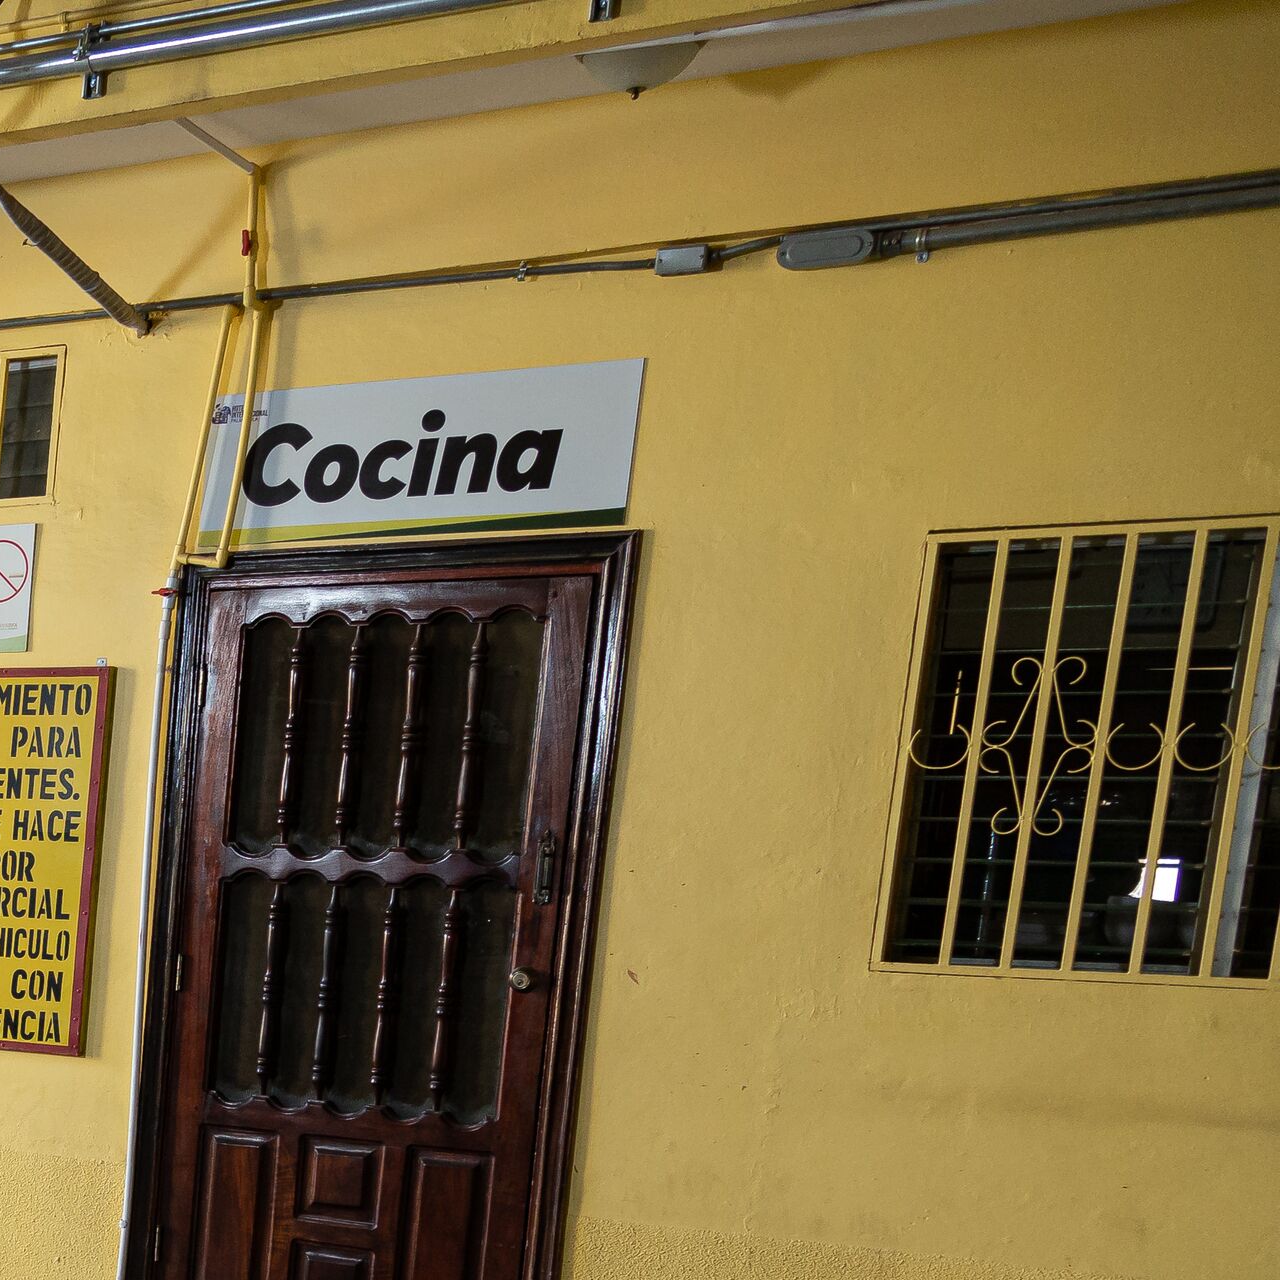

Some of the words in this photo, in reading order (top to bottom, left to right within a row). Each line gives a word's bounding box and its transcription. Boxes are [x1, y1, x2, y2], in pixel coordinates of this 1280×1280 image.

[242, 409, 563, 507] Cocina
[11, 726, 82, 758] PARA
[12, 809, 82, 842] HACE
[11, 969, 64, 1002] CON
